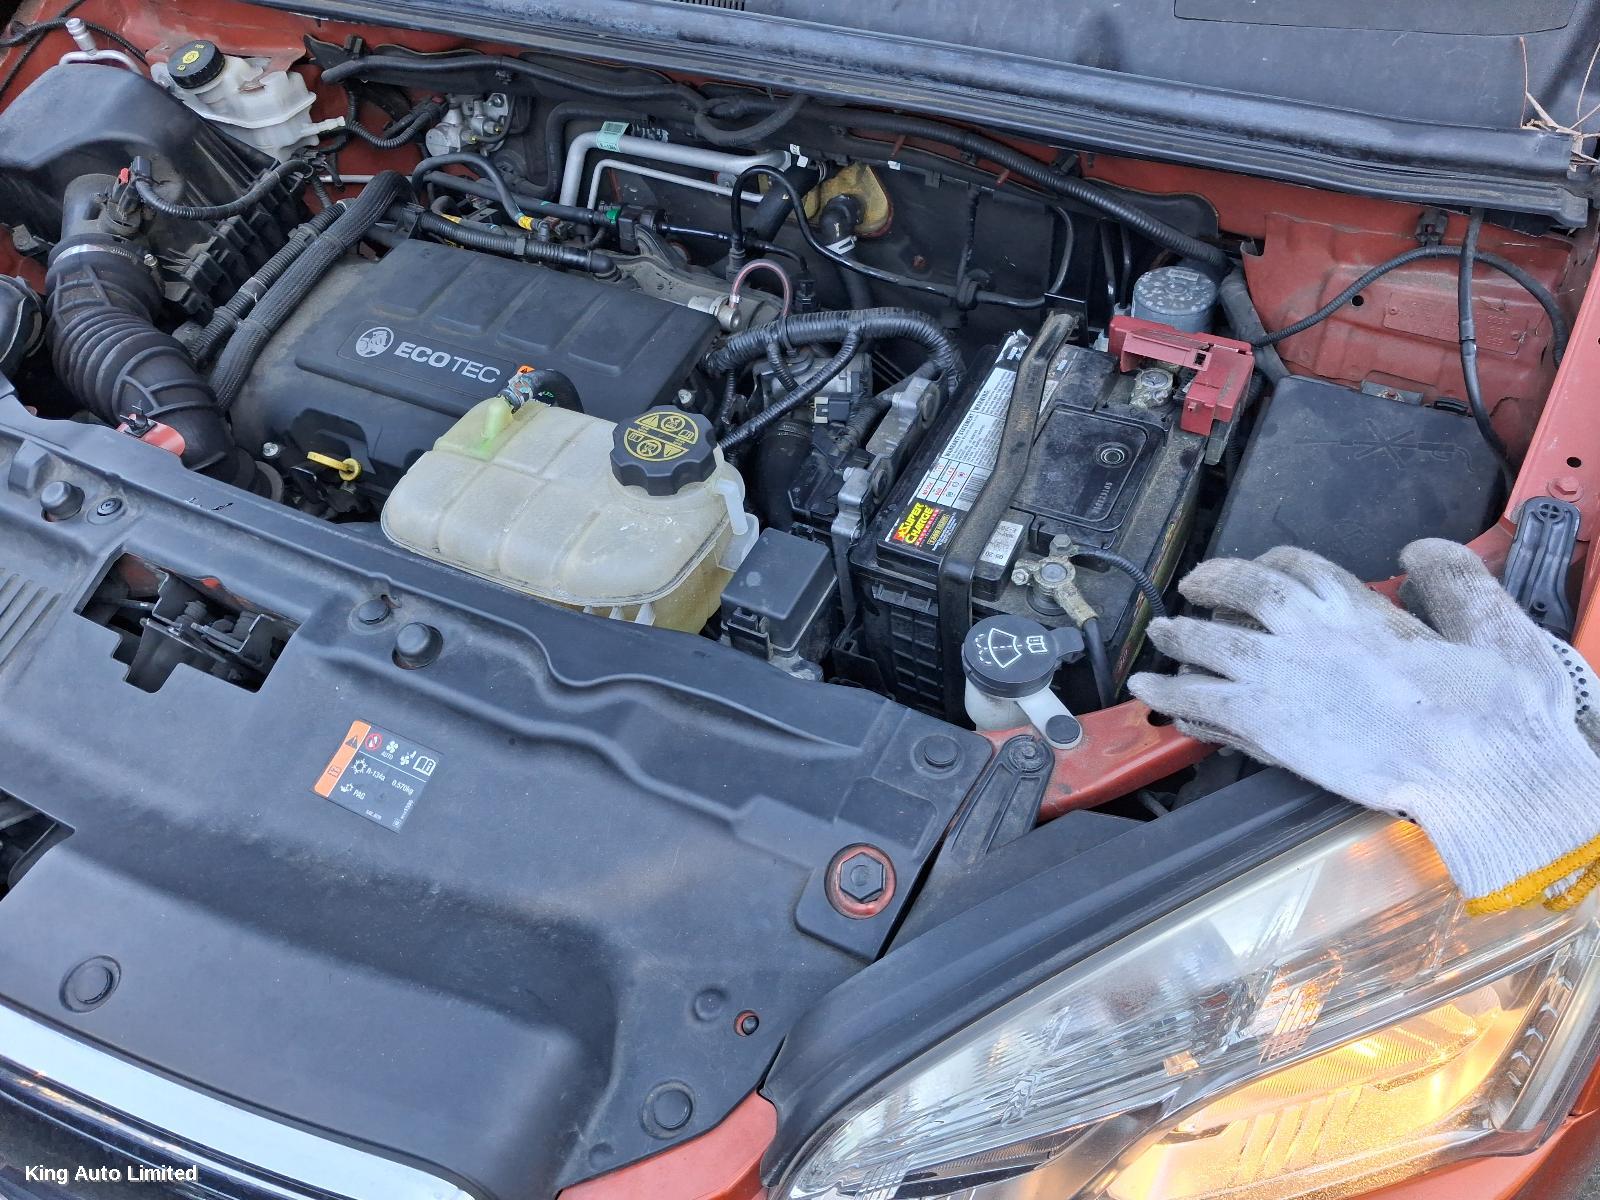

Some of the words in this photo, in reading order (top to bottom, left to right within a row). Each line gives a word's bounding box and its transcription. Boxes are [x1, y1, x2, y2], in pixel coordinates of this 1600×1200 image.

[393, 341, 501, 384] ECOTEC
[901, 502, 925, 531] SUPER
[905, 505, 934, 544] CHARGE
[381, 751, 394, 760] AUTO
